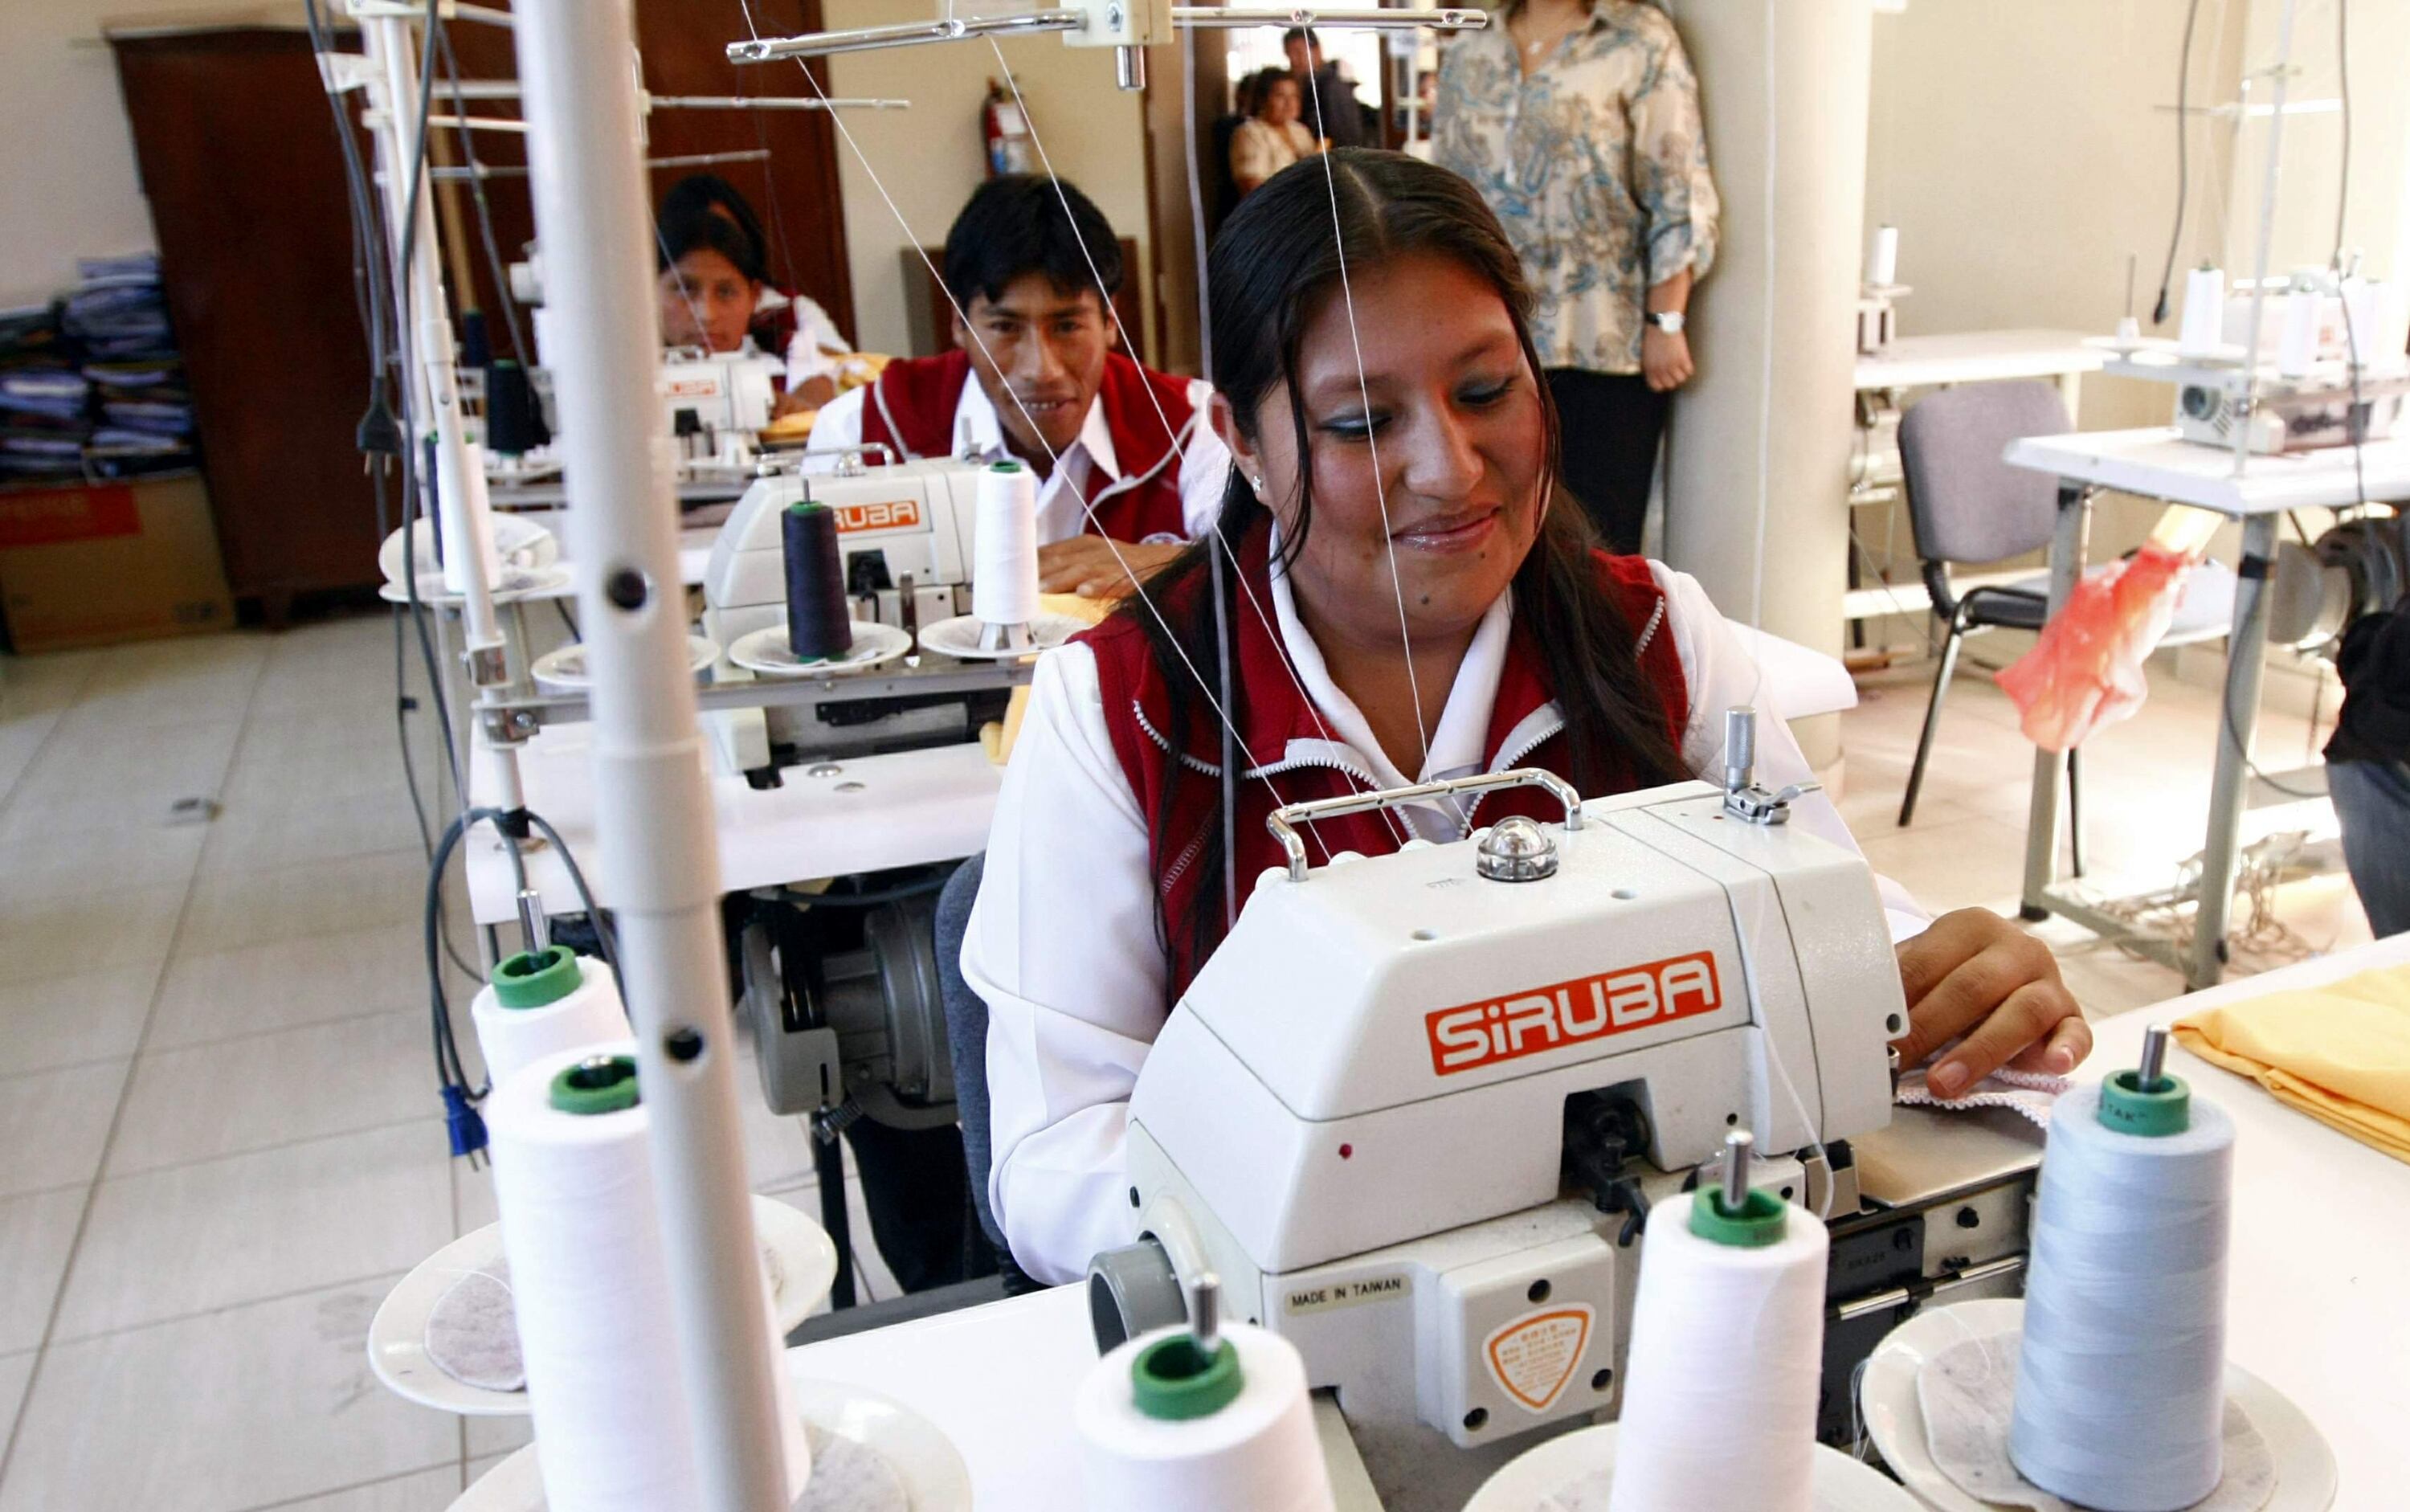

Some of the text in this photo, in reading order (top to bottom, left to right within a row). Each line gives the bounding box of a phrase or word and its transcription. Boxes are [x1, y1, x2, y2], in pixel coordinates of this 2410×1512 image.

[1292, 1278, 1401, 1307] MADE IN TAIWAN
